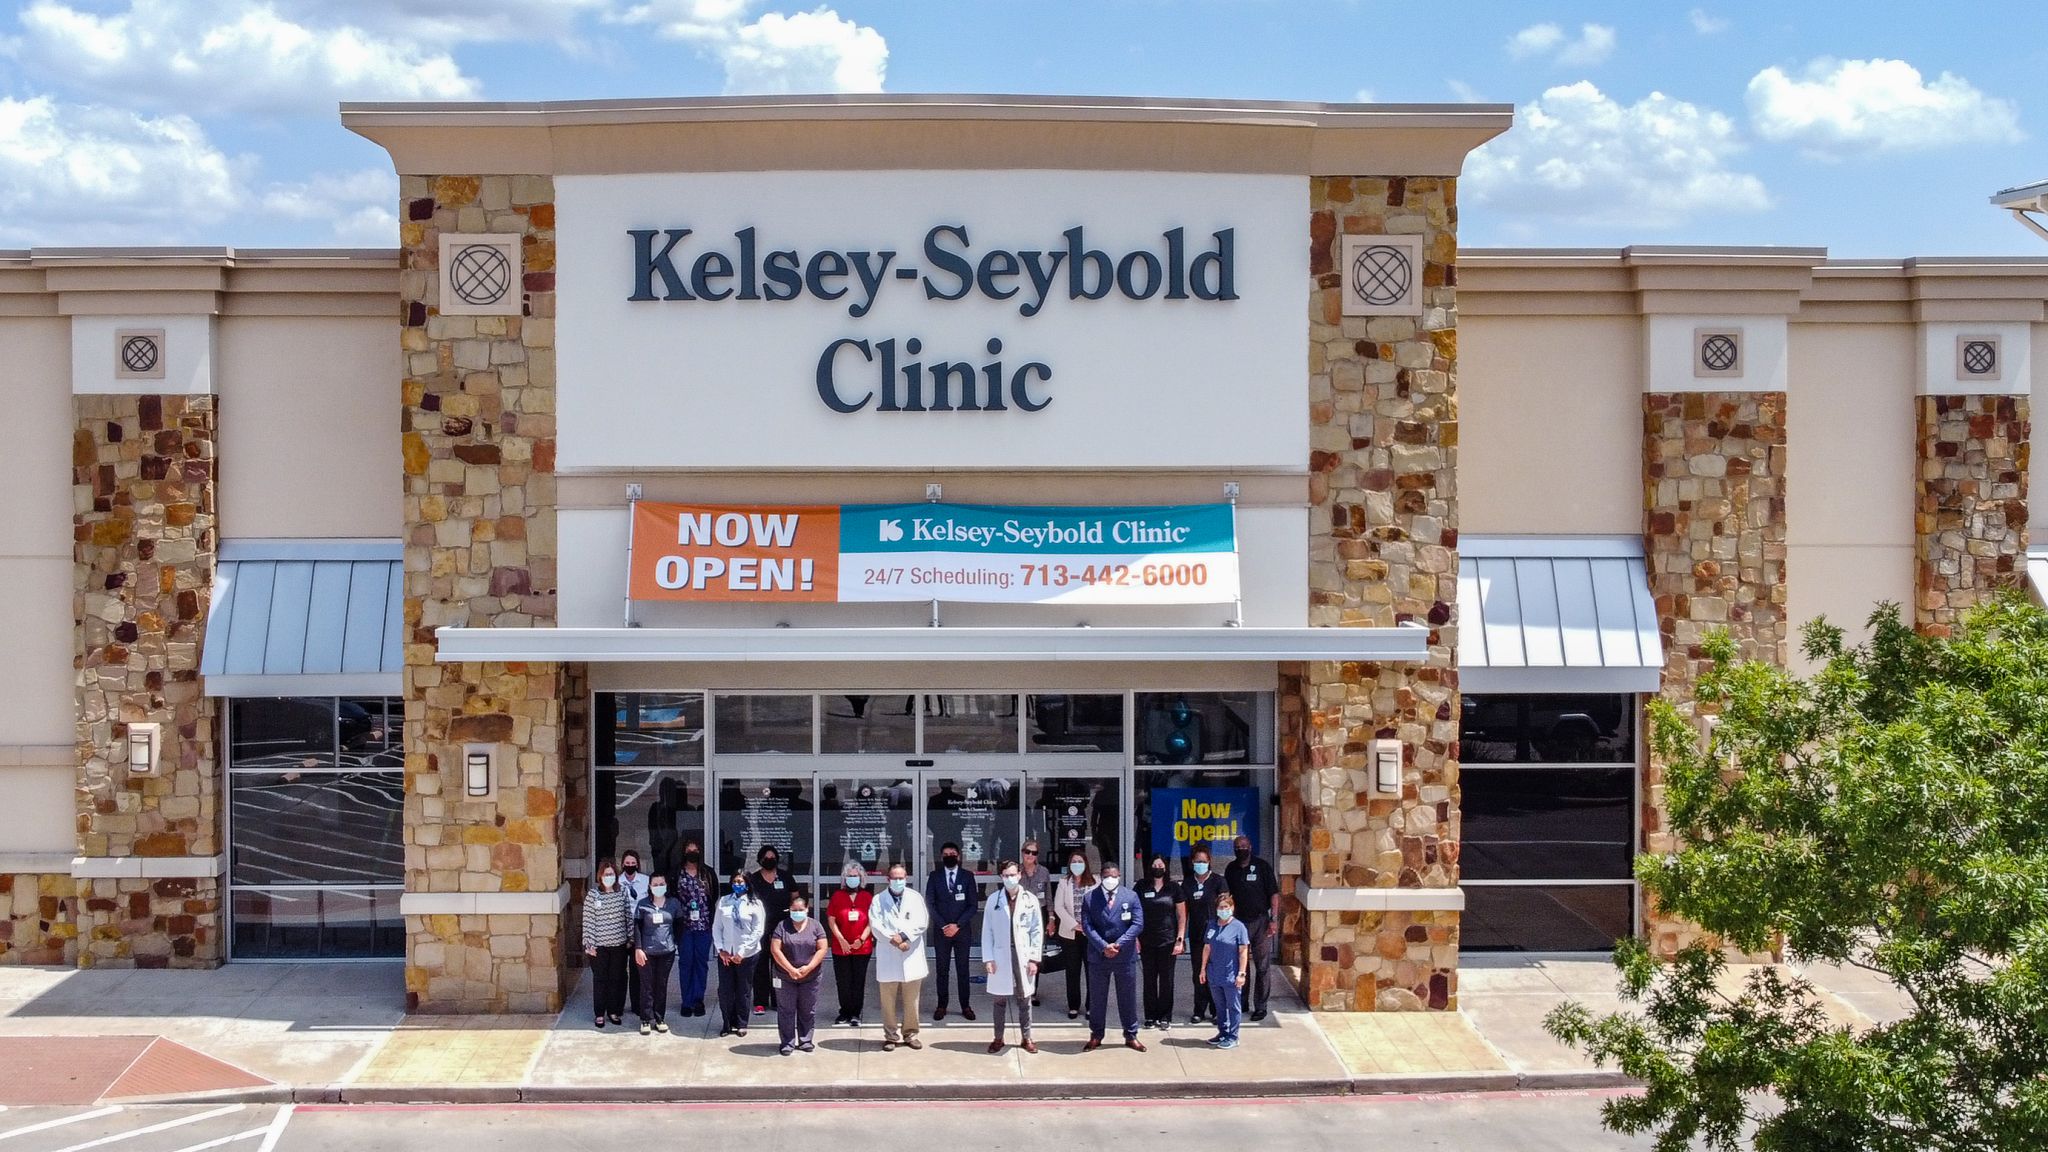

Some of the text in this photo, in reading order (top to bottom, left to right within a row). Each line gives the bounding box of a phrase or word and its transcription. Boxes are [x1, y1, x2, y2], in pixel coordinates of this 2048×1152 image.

[626, 224, 1240, 318] Kelsey-Seybold
[815, 337, 1053, 414] Clinic
[678, 512, 800, 547] NOW
[912, 518, 1104, 548] Kelsey-Seybold
[655, 555, 814, 591] OPEN!
[864, 563, 1208, 590] 24/7 Scheduling: 713-442-6000
[1181, 798, 1232, 819] Now
[1174, 820, 1237, 846] Open!
